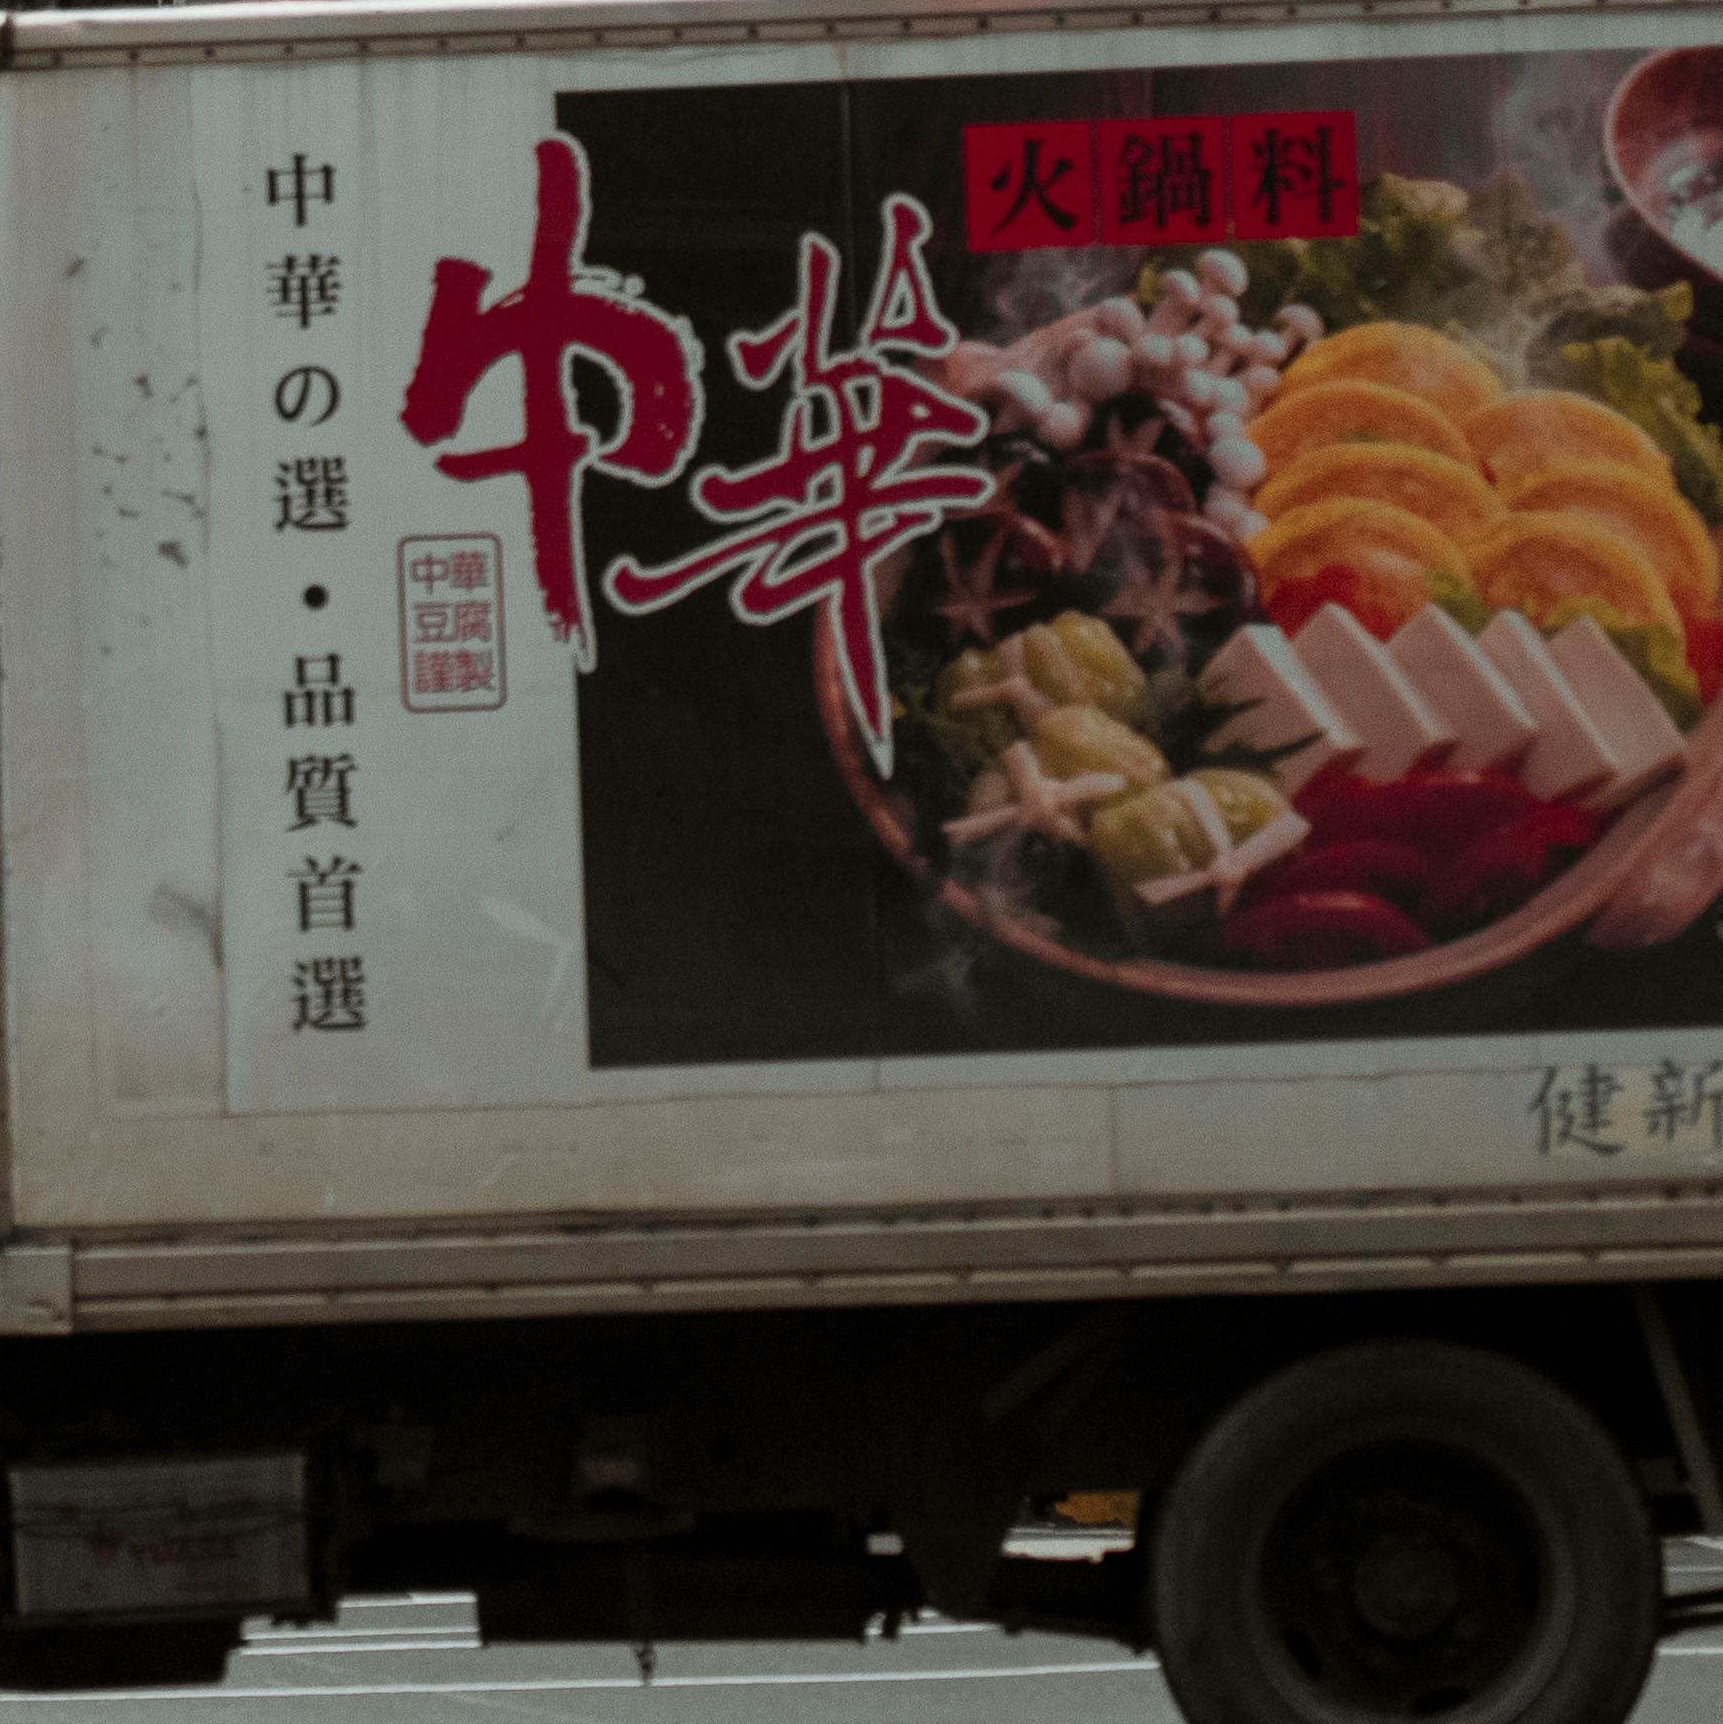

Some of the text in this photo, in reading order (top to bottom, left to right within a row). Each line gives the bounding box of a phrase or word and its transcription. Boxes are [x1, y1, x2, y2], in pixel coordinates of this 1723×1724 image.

[990, 124, 1346, 236] 火鍋料
[401, 131, 995, 781] 中華
[410, 552, 488, 593] 中華
[413, 602, 491, 642] 豆腐
